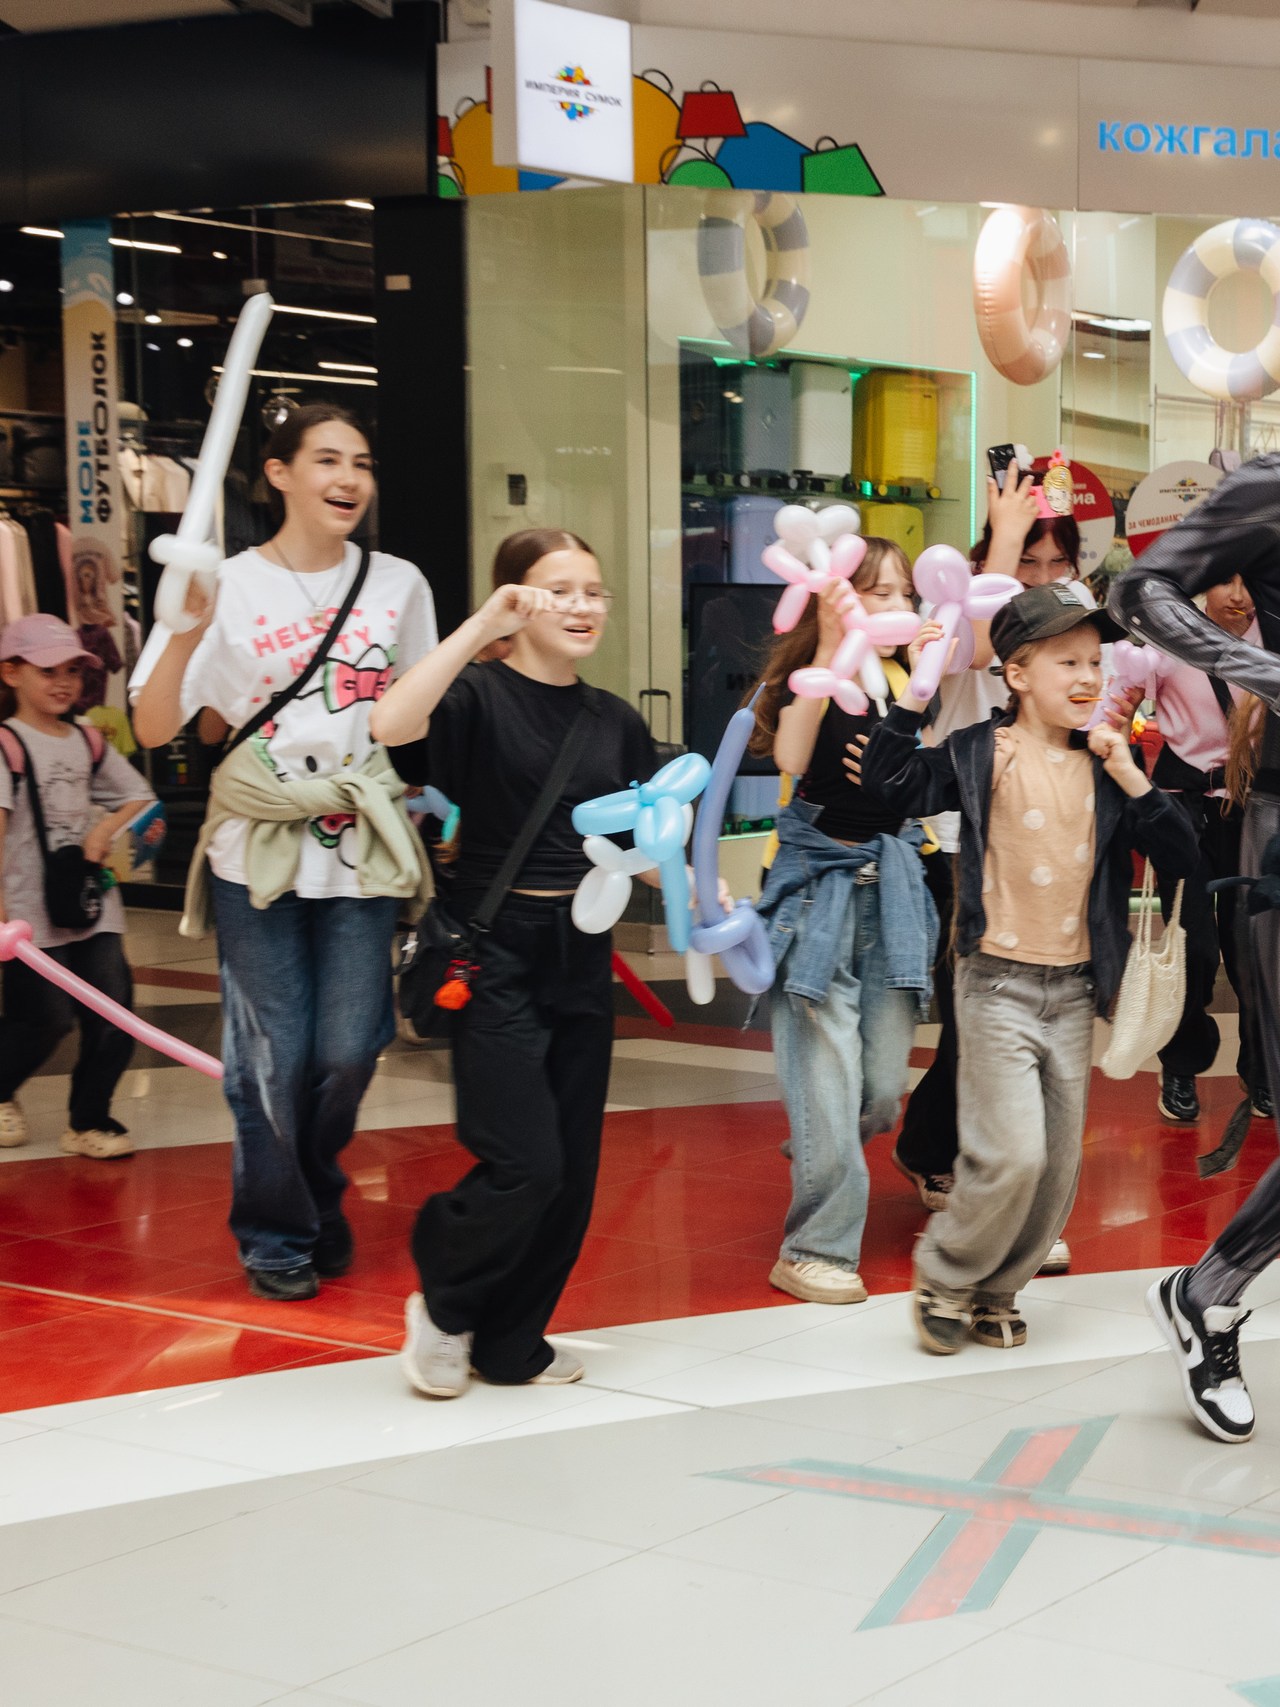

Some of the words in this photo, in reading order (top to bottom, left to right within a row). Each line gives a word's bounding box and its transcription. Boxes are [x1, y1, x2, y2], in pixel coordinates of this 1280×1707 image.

[584, 91, 623, 108] СУМОК
[77, 420, 94, 524] МОРЕ
[91, 331, 112, 524] ФУТБОЛОК
